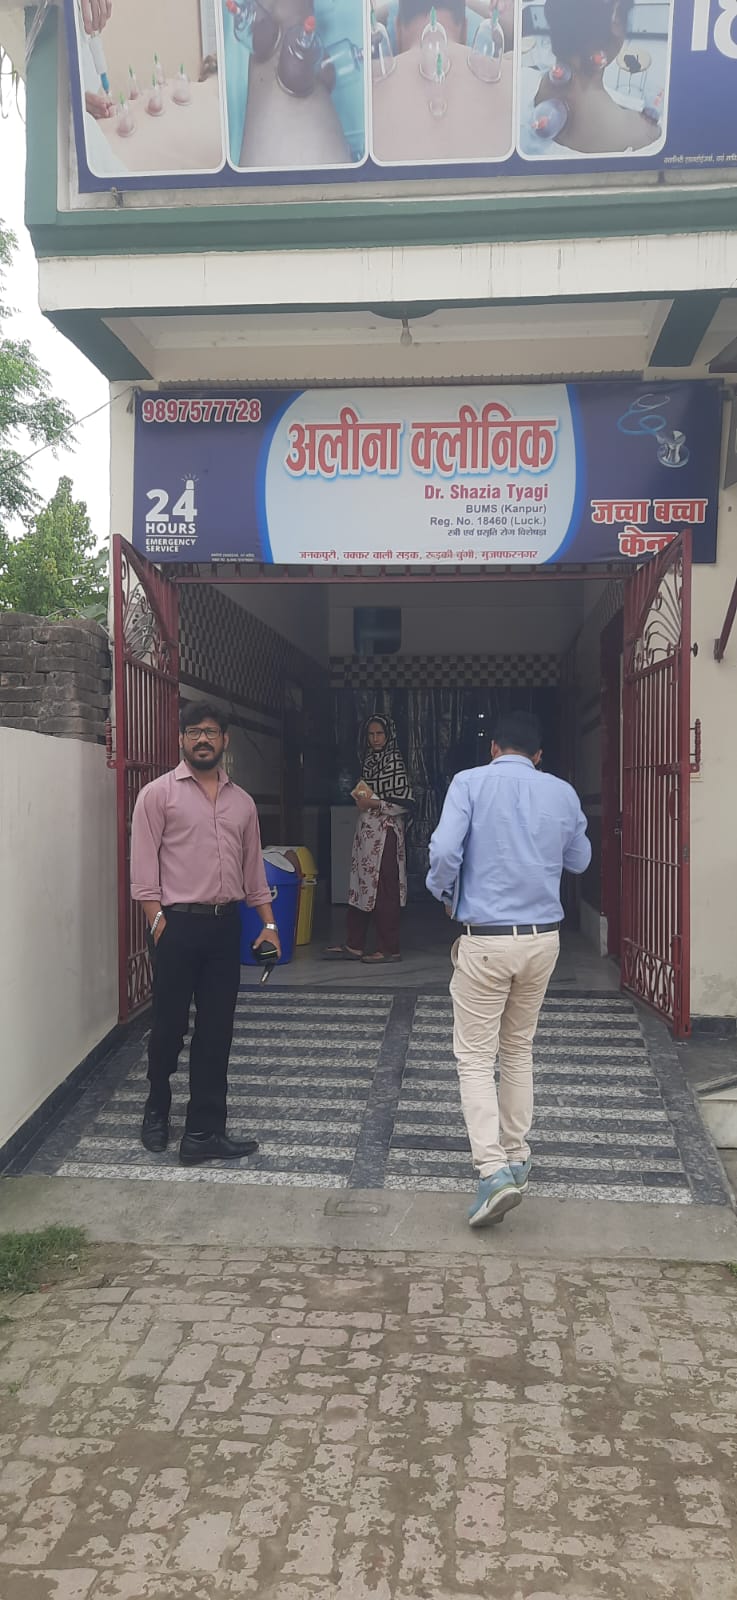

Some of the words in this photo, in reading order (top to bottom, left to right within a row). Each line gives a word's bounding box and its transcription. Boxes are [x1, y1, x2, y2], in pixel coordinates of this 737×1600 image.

[142, 398, 262, 423] 9897577728
[284, 404, 403, 476] अलीना
[409, 400, 559, 475] क्लीनिक
[424, 485, 444, 499] Dr.
[450, 484, 501, 499] Shazia
[506, 483, 549, 502] Tyagi
[145, 488, 198, 522] 24
[465, 504, 498, 514] BUMS
[501, 503, 547, 514] (Kanpur)
[591, 499, 651, 524] जच्चा
[653, 498, 708, 524] बच्चा
[430, 516, 453, 527] Reg.
[456, 516, 474, 526] No.
[477, 516, 508, 526] 18460
[510, 516, 547, 527] (Luck.)
[145, 522, 197, 534] HOURS
[145, 538, 197, 546] EMERGENCY
[145, 545, 180, 553] SERVICE
[372, 549, 393, 560] वाली
